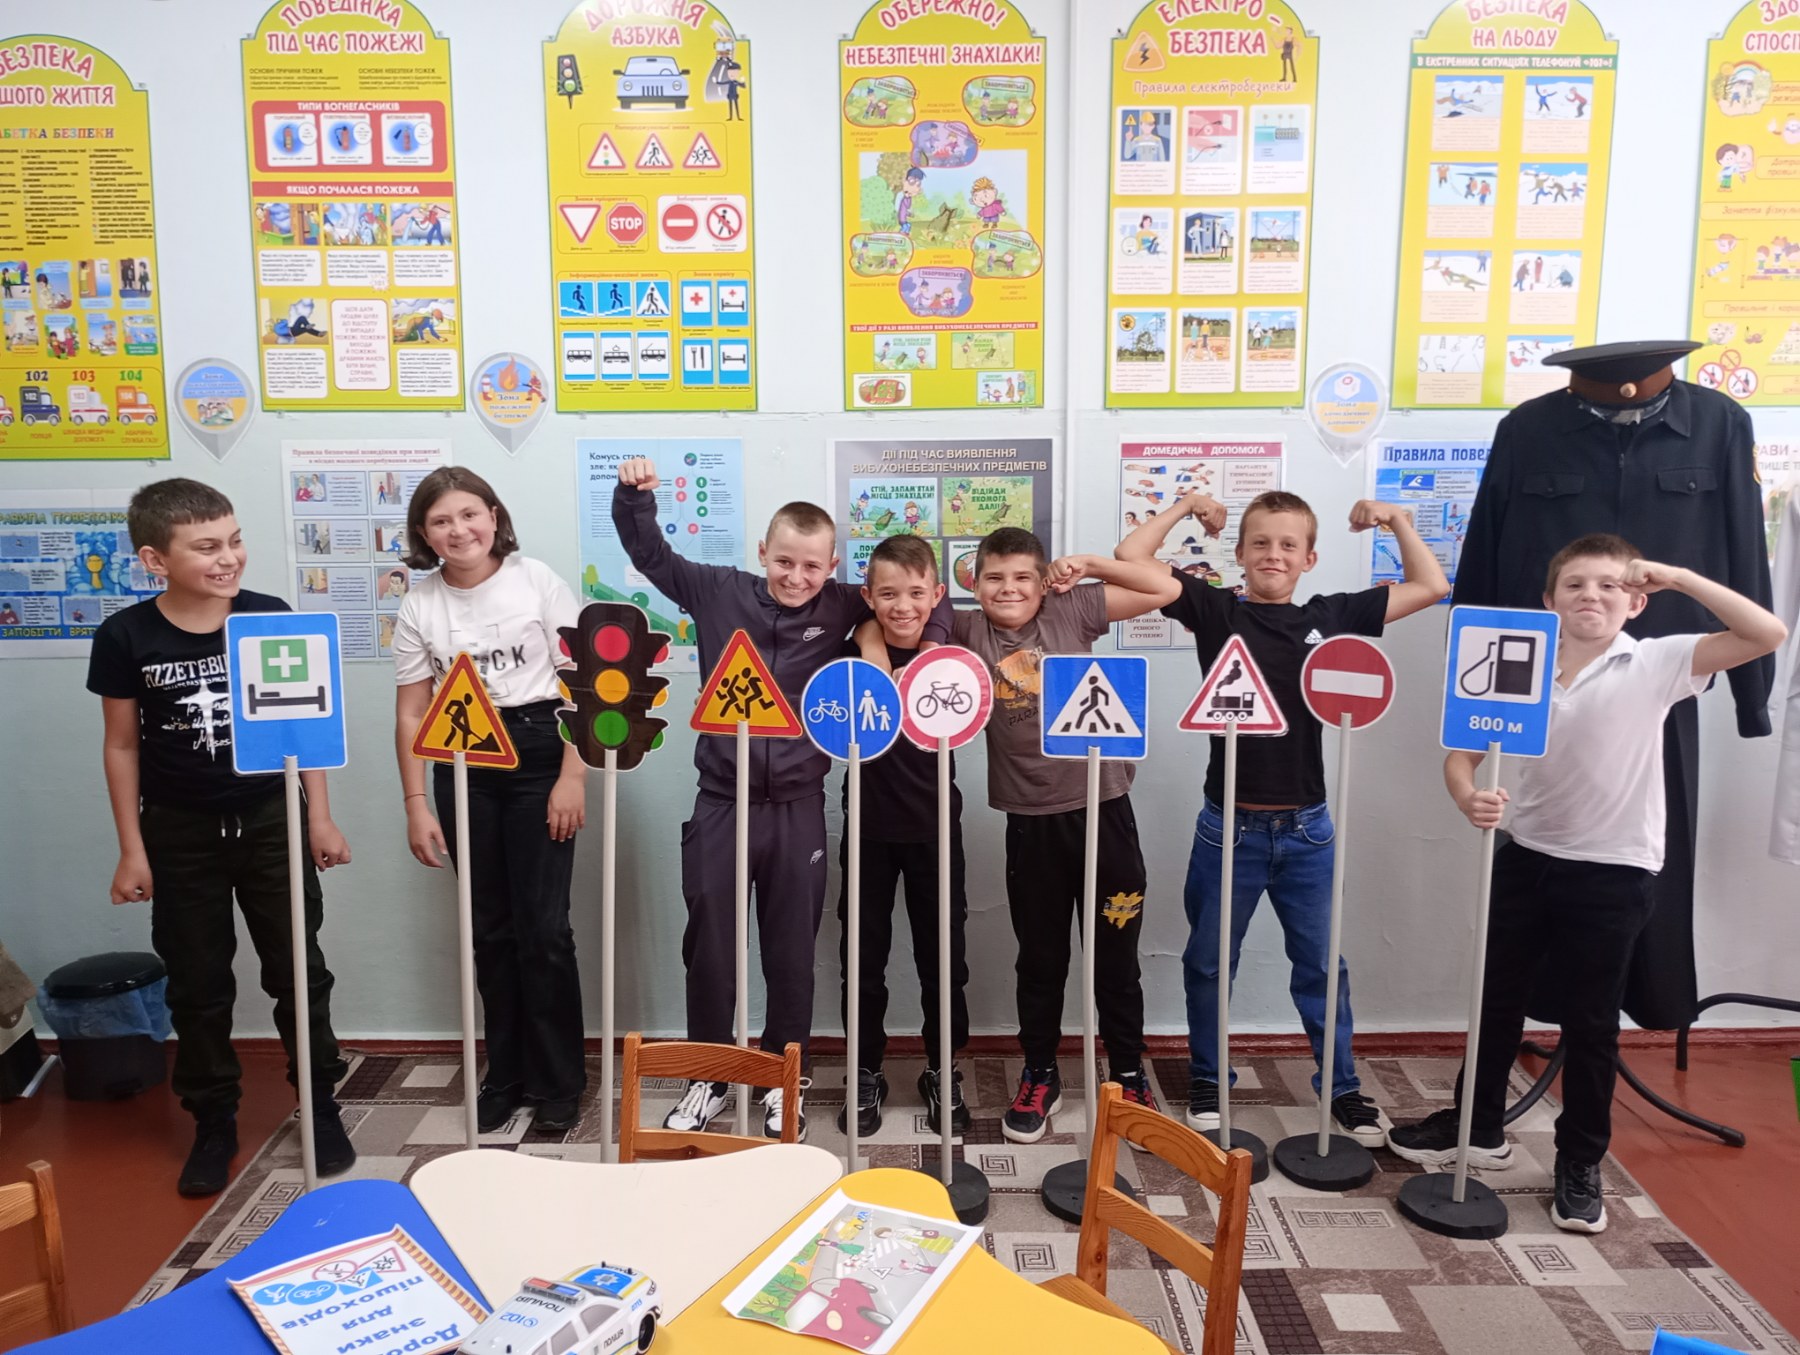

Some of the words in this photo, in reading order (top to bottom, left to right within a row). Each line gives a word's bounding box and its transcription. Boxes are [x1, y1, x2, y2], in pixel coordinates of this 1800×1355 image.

[281, 0, 401, 27] ПОВЕДІНКА
[584, 0, 706, 31] ДОРОЖНЯ
[881, 0, 1006, 28] ОБЕРЕЖНО!
[1466, 0, 1569, 24] БЕЗПЕКА
[267, 33, 299, 52] ПІД
[304, 34, 339, 52] ЧАС
[345, 33, 423, 52] ПОЖЕЖІ
[612, 26, 681, 46] АЗБУКА
[1169, 31, 1266, 55] БЕЗПЕКА
[1473, 29, 1496, 46] НА
[1502, 29, 1557, 47] ЛЬОДУ
[846, 47, 945, 65] НЕБЕЗПЕЧНІ
[951, 45, 1041, 64] ЗНАХІДКИ!
[53, 86, 114, 105] ЖИТТЯ
[1134, 81, 1186, 98] Правила
[298, 102, 322, 111] ТИПИ
[324, 102, 400, 111] ВОГНЕГАСНИКІВ
[53, 128, 115, 139] БЕЗПЕКИ
[286, 185, 316, 195] ЯКЩО
[319, 185, 373, 195] ПОЧАЛАСЯ
[375, 185, 419, 195] ПОЖЕЖА
[610, 217, 642, 230] STOP
[25, 370, 48, 382] 102
[72, 370, 96, 382] 103
[119, 370, 143, 381] 104
[589, 452, 621, 463] Комусь
[881, 449, 897, 461] ДІЇ
[899, 449, 919, 461] ПІД
[921, 449, 945, 460] ЧАС
[946, 448, 1017, 459] ВИЯВЛЕННЯ
[1143, 446, 1204, 456] ДОМЕДИЧНА
[1211, 445, 1266, 455] ДОПОМОГА
[1384, 446, 1445, 463] Правила
[590, 463, 607, 471] зле:
[851, 462, 981, 474] ВИБУХОНЕБЕЗПЕЧНИХ
[983, 461, 1048, 473] ПРЕДМЕТІВ
[1469, 715, 1504, 732] 800
[280, 1275, 425, 1330] пішоходів
[341, 1305, 394, 1331] для
[336, 1317, 427, 1355] знаки
